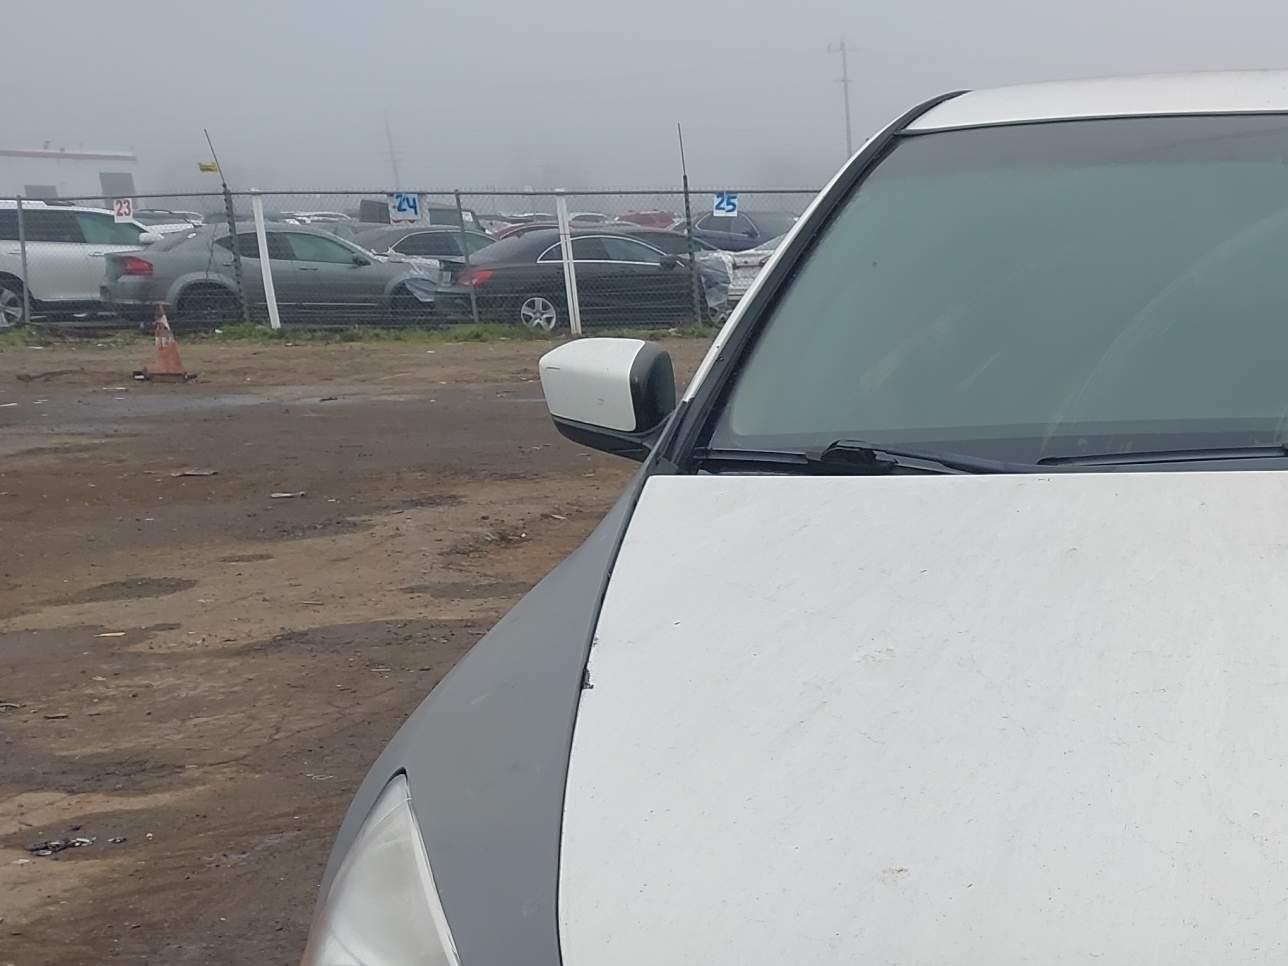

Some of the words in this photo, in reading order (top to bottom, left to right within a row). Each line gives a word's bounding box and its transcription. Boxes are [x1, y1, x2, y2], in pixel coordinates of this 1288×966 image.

[115, 199, 131, 216] 23
[395, 194, 418, 216] 24
[715, 192, 737, 212] 25
